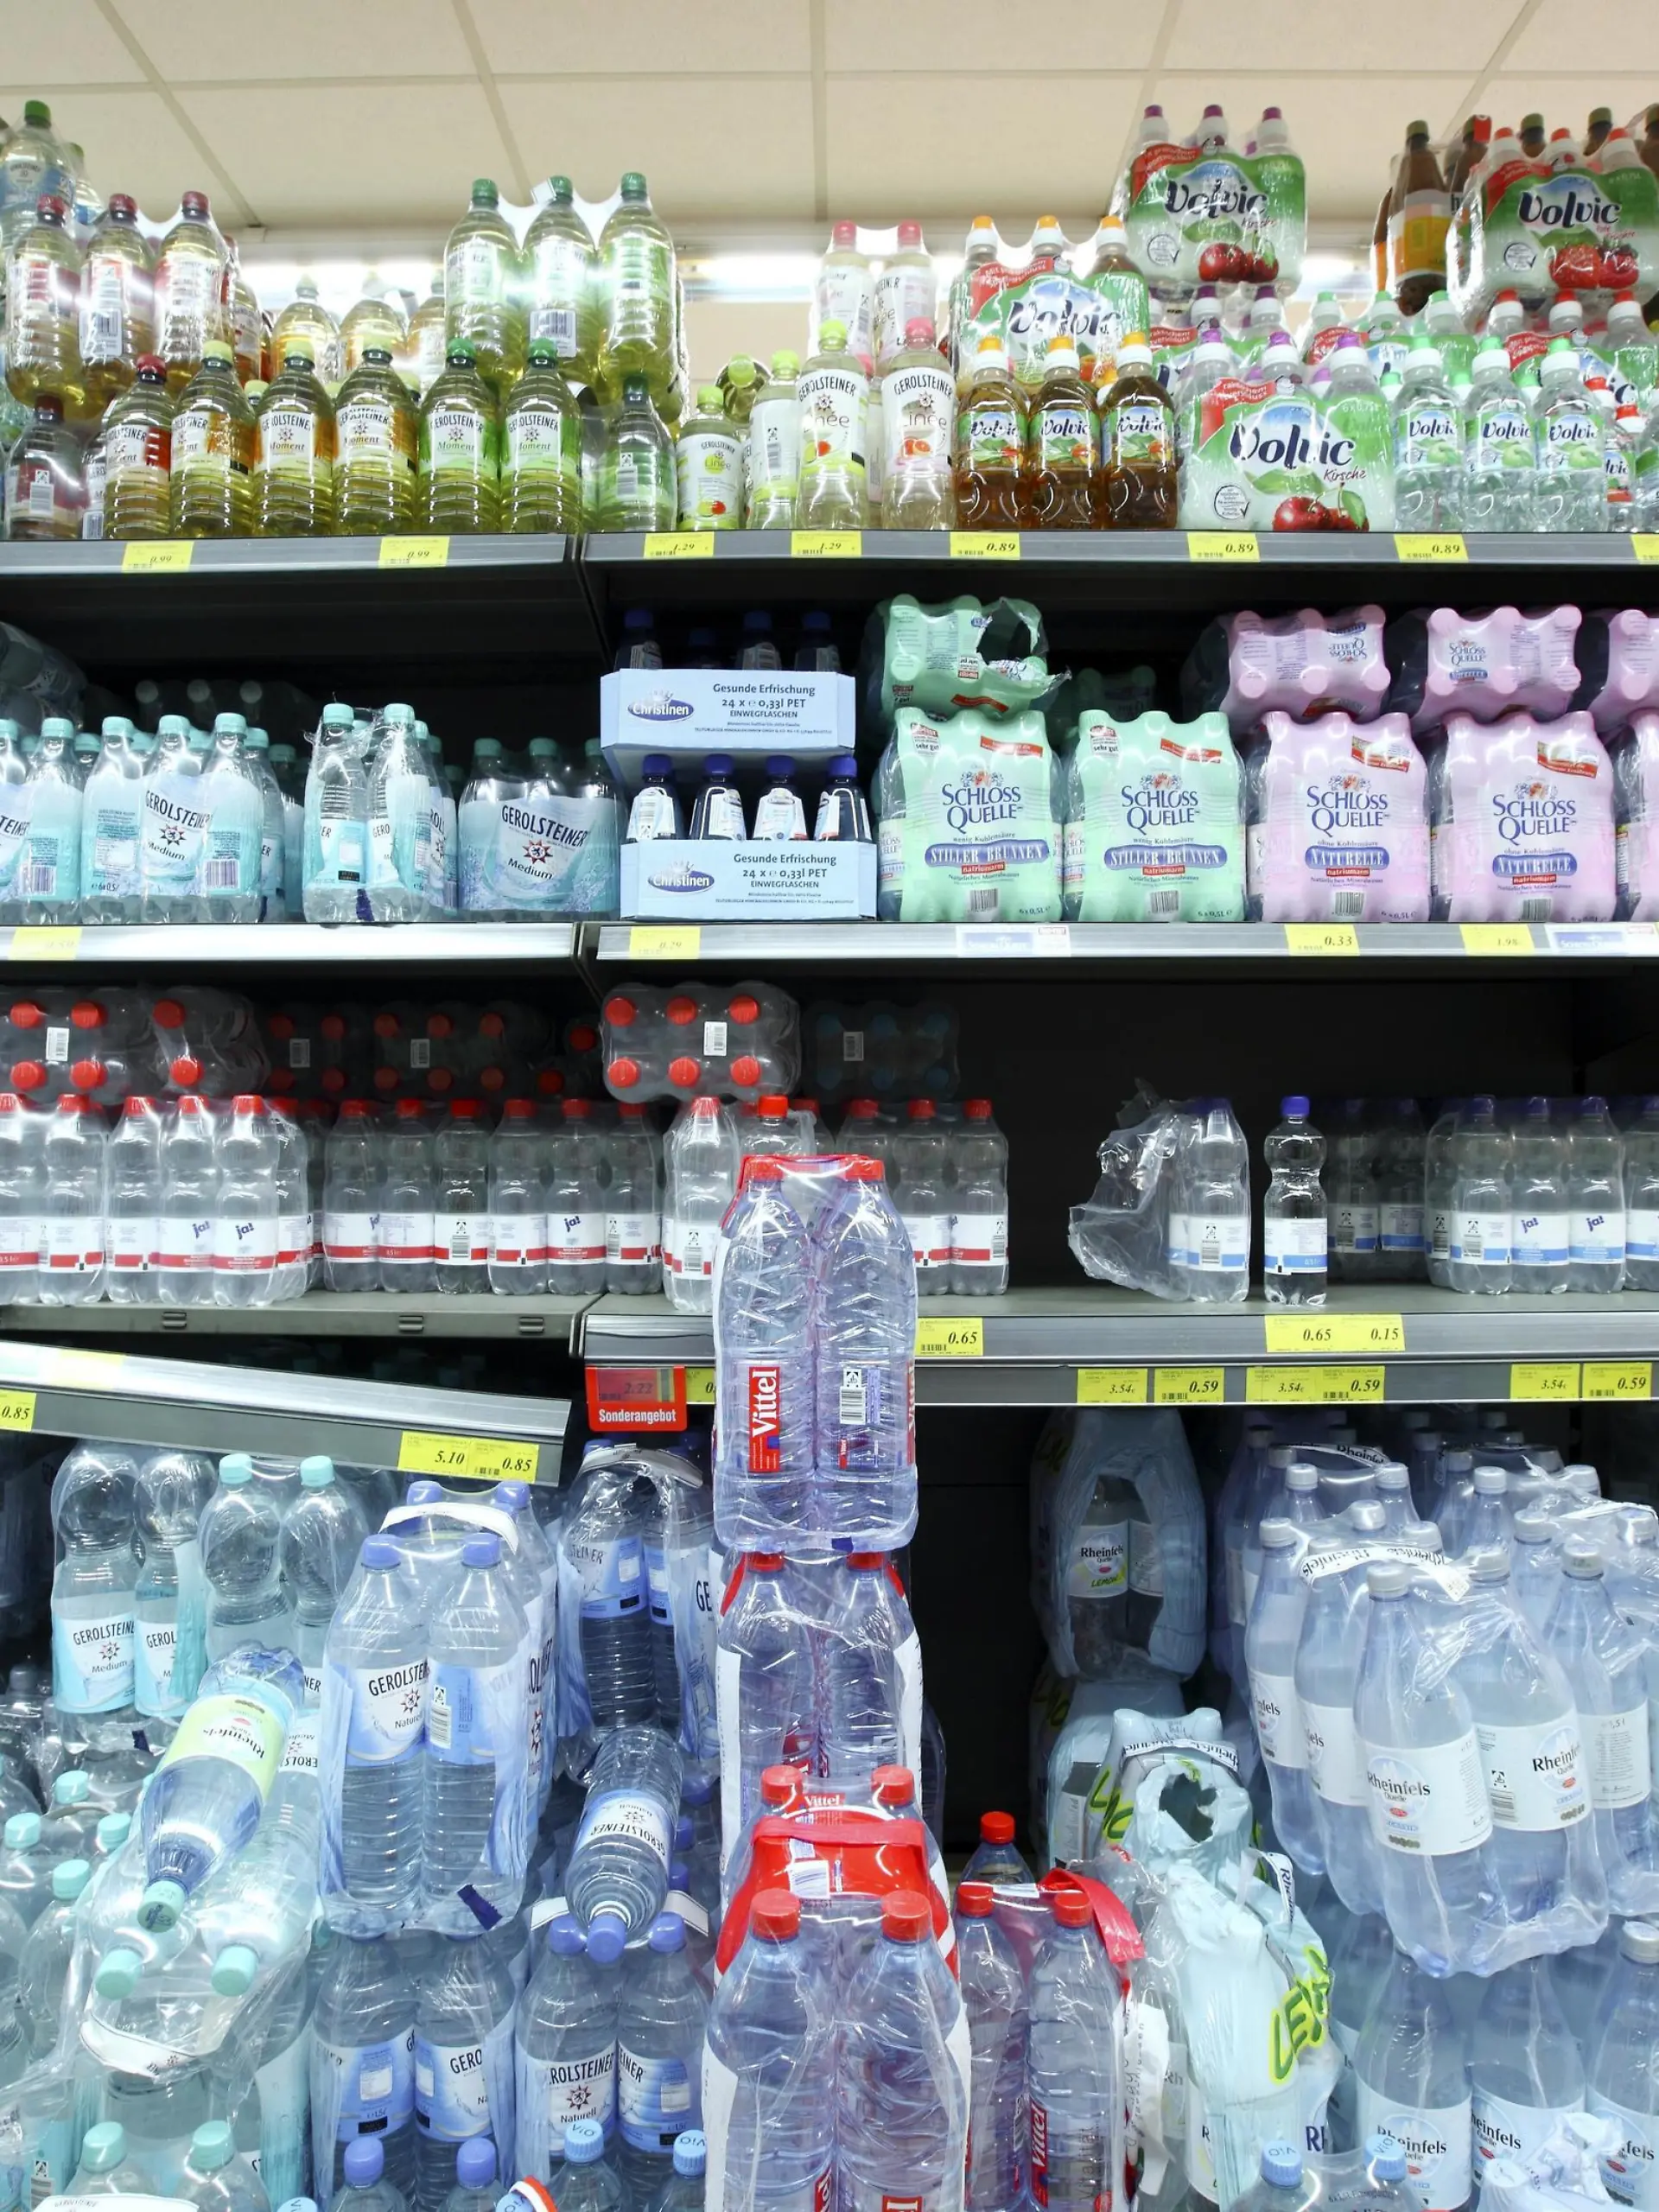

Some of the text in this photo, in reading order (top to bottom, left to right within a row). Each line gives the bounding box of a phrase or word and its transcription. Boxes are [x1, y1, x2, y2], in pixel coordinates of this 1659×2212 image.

[1165, 178, 1268, 219] Volvic
[1518, 191, 1621, 228] Volvic
[798, 374, 856, 404] GEROLSTEINER
[893, 372, 954, 400] GEROLSTEINER
[1041, 418, 1090, 437] Volvic
[1230, 423, 1355, 470] Volvic
[1323, 465, 1368, 482] Kirsche
[673, 543, 696, 554] 1.29
[820, 542, 842, 553] 1.29
[986, 543, 1016, 552] 0.89
[1225, 543, 1255, 554] 0.89
[1432, 543, 1460, 554] 0.89
[713, 683, 816, 697] Gesunde Erfrischung
[631, 702, 690, 717] Christinen
[721, 699, 735, 709] 24
[787, 698, 807, 709] PET
[729, 709, 798, 719] EINWEGFLASCHEN
[942, 784, 1021, 807] SCHLOSS
[1121, 785, 1198, 809] SCHLOSS
[1306, 785, 1389, 810] SCHLOSS
[1492, 794, 1576, 817] SCHLOSS
[501, 804, 588, 848] GEROLSTEINER
[947, 804, 1018, 835] QUELLE
[1127, 807, 1196, 836] QUELLE
[1312, 808, 1383, 838] QUELLE
[1498, 817, 1571, 846] QUELLE
[148, 841, 185, 862] Medium
[734, 853, 837, 867] Gesunde Erfrischung
[930, 842, 1046, 864] STILLER BRUNNEN
[1109, 849, 1221, 866] STILLER BRUNNEN
[1310, 848, 1384, 866] NATURELLE
[508, 856, 554, 881] Medium
[742, 868, 756, 879] 24
[808, 868, 827, 878] PET
[1497, 856, 1572, 874] NATURELLE
[652, 873, 710, 887] Christinen
[749, 880, 820, 889] EINWEGFLASCHEN
[1325, 936, 1352, 946] 0.33
[192, 1220, 211, 1240] ja!
[235, 1222, 255, 1240] ja!
[563, 1215, 581, 1232] ja!
[1521, 1217, 1540, 1234] ja!
[1586, 1215, 1605, 1232] ja!
[948, 1332, 977, 1344] 0.65
[1303, 1328, 1332, 1342] 0.65
[1370, 1327, 1399, 1341] 0.15
[1109, 1383, 1133, 1395] 3.54
[1188, 1380, 1219, 1394] 0.59
[1278, 1382, 1301, 1394] 3.54
[1351, 1379, 1380, 1393] 0.59
[1541, 1379, 1564, 1390] 3.54
[1618, 1376, 1646, 1390] 0.59
[751, 1369, 778, 1438] Vittel
[1, 1406, 30, 1422] 0.85
[599, 1408, 677, 1425] Sonderangebot
[435, 1449, 466, 1465] 5.10
[502, 1457, 533, 1471] 0.85
[1080, 1542, 1124, 1559] Rheinfels
[92, 1659, 128, 1675] Medium
[1367, 1770, 1431, 1796] Rheinfels
[804, 1794, 841, 1807] Vittel
[1031, 2107, 1047, 2170] Vittel
